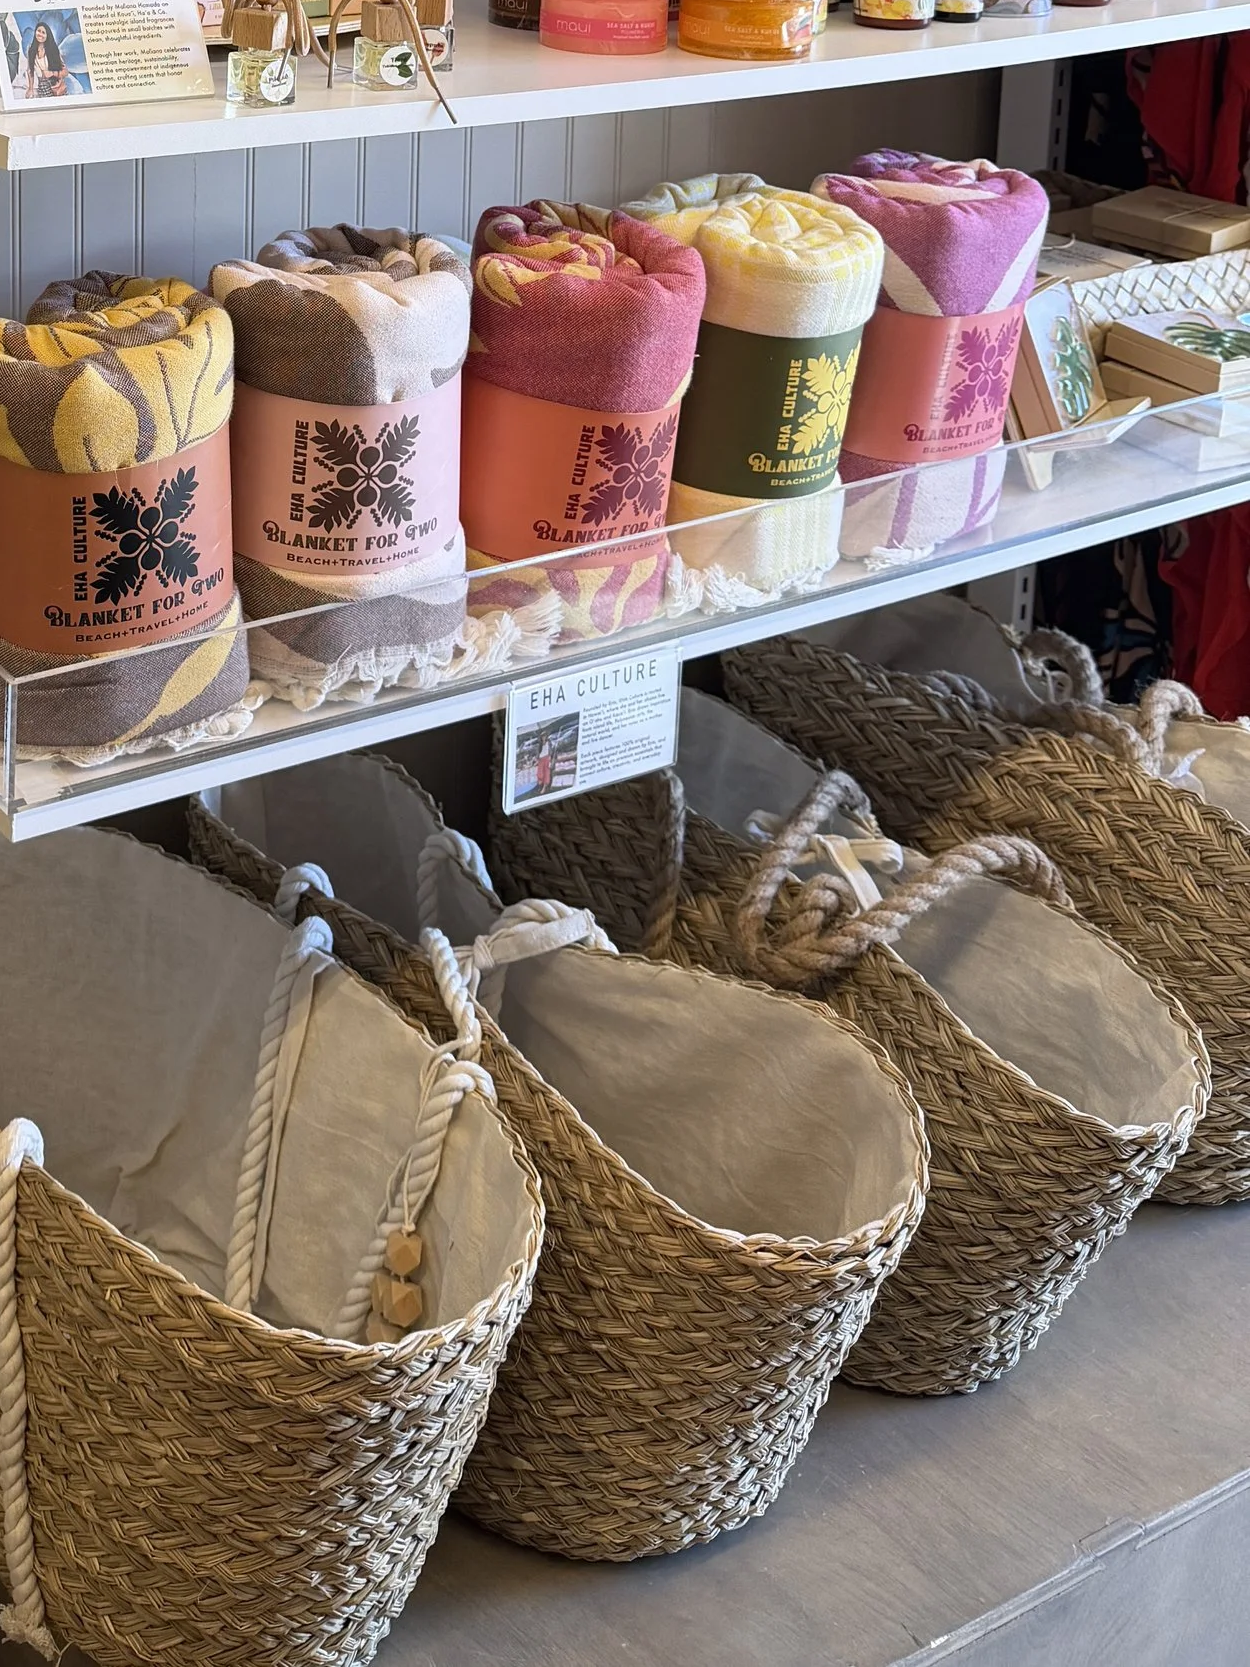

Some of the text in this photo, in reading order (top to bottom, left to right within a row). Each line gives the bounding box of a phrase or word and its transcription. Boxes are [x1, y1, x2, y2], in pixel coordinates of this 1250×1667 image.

[557, 19, 590, 33] maui
[777, 359, 802, 451] EHA CULTURE
[903, 418, 994, 442] BLANKET FOR
[290, 420, 309, 522] EHA CULTURE
[564, 425, 596, 520] EHA CULTURE
[748, 453, 824, 473] BLANKET
[73, 496, 88, 601] EHA CULTURE
[262, 518, 437, 552] BLANKET FOR TWO
[533, 520, 649, 544] BLANKET FOR
[286, 546, 420, 567] BEACH+TRAVEL+HOME
[44, 567, 224, 627] BLANKET FOR TWO
[75, 600, 208, 642] BEACH+TRAVEL+HOME
[531, 659, 656, 710] EHA CULTURE
